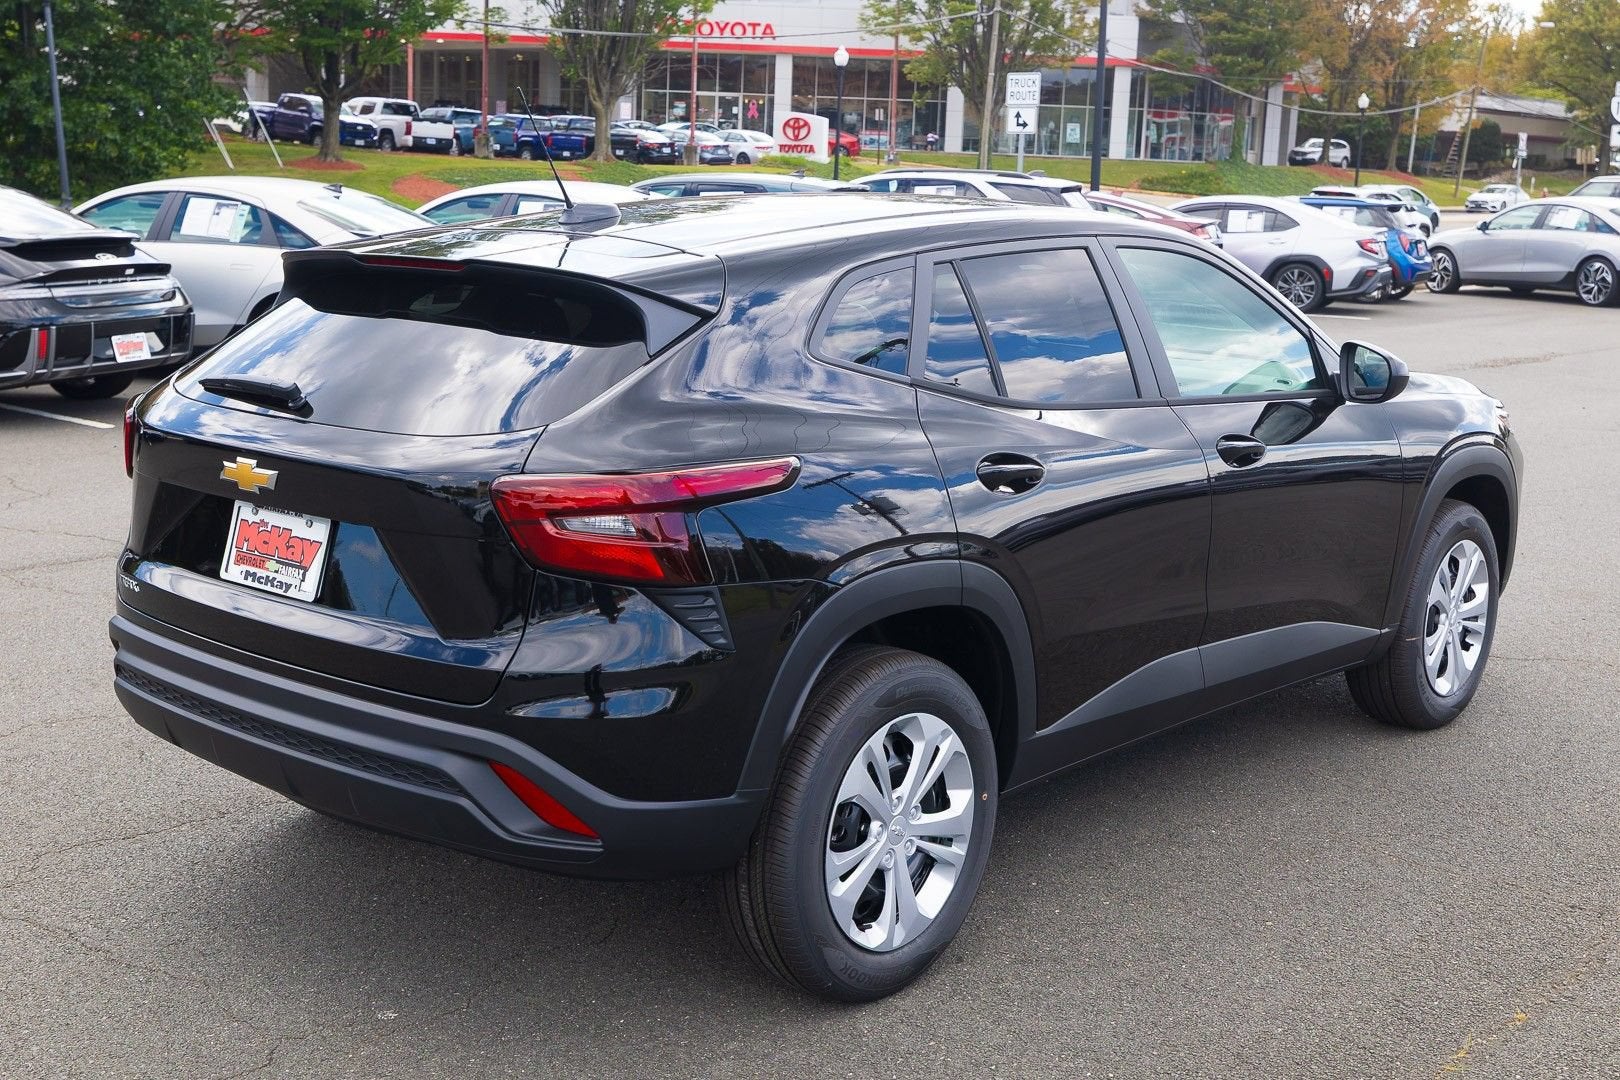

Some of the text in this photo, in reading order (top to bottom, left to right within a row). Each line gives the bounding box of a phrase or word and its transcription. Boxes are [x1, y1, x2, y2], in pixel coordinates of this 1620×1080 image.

[1010, 78, 1037, 88] TRUCK
[1010, 90, 1037, 101] ROUTE
[778, 143, 816, 154] TOYOTA
[235, 518, 323, 571] McKay
[236, 553, 304, 579] CHEVROLET FAIRFAX
[243, 569, 293, 593] McKay
